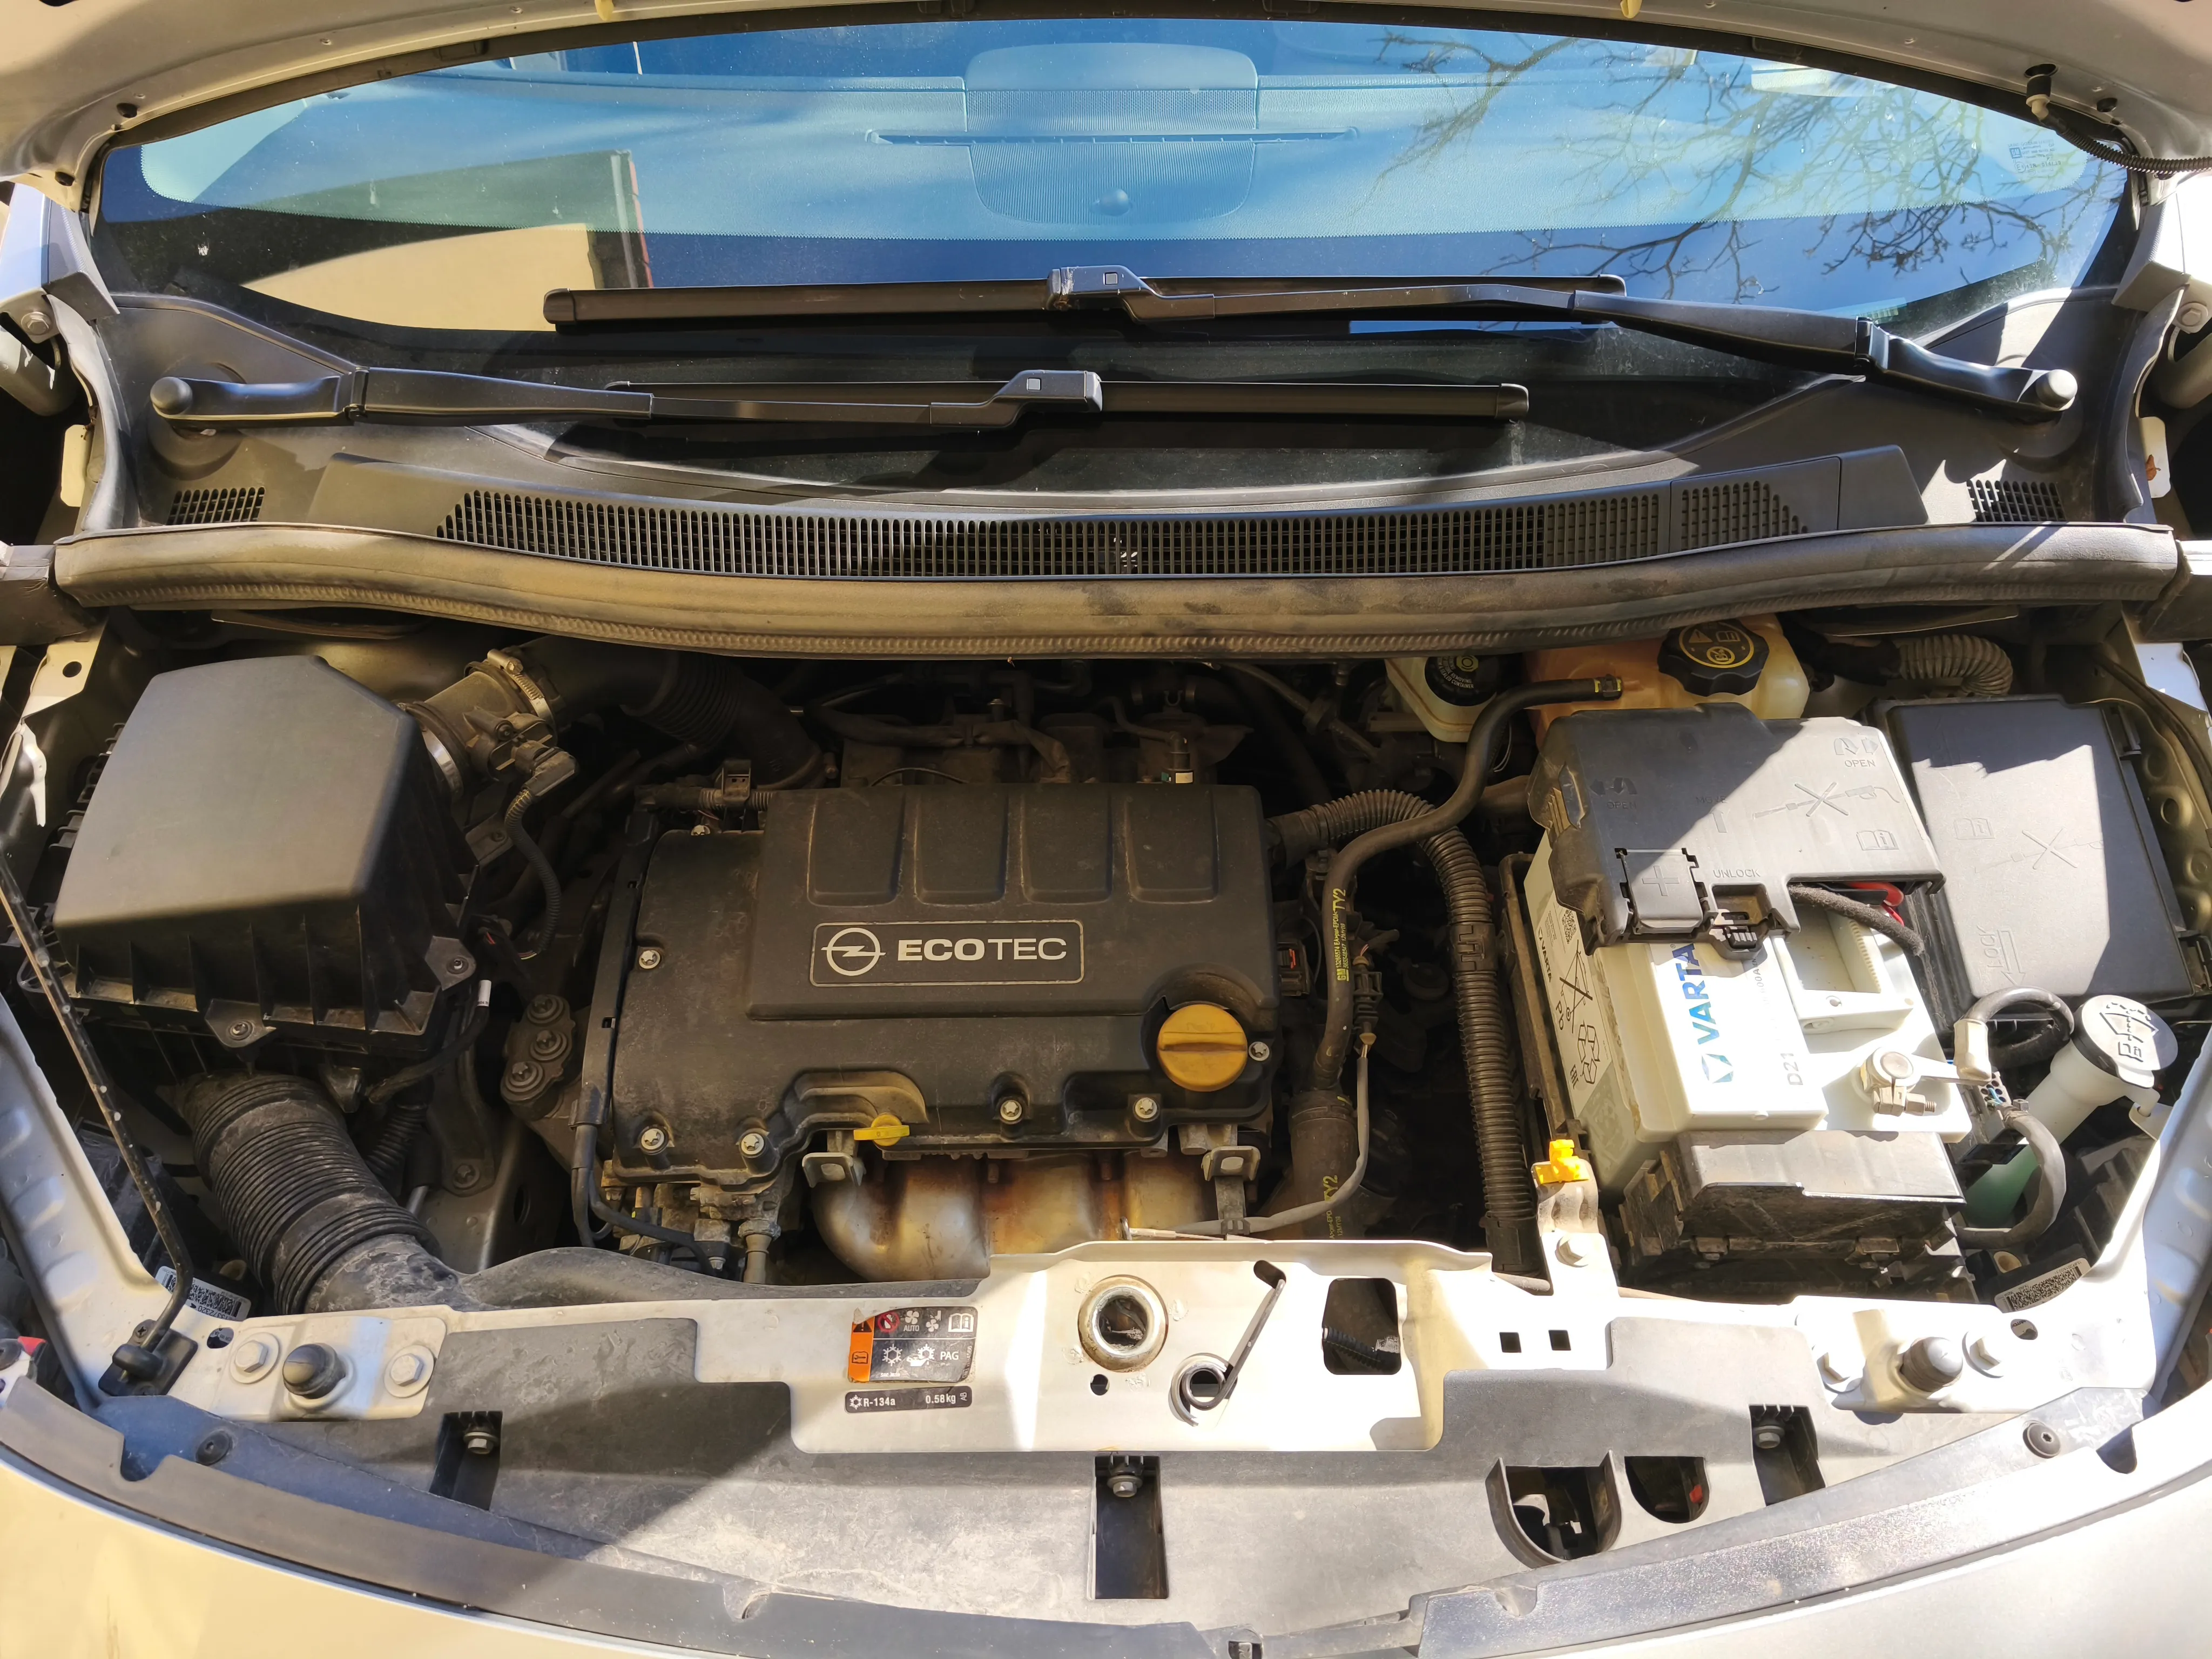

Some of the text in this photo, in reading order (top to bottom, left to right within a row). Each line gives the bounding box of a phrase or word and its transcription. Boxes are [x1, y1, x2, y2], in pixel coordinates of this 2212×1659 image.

[1844, 759, 1876, 767] OPEN
[1606, 801, 1637, 809] OPEN
[1712, 868, 1761, 878] UNLOCK
[1332, 888, 1346, 911] TY2
[898, 938, 1067, 961] ECOTEC
[1975, 925, 1996, 968] LOCK
[1541, 943, 1552, 982] VARTA
[1675, 943, 1719, 1044] VARTA
[1555, 1000, 1564, 1030] Pb
[1781, 1052, 1804, 1086] D21
[940, 1352, 959, 1360] PAG
[864, 1398, 896, 1407] R-134a
[960, 1392, 967, 1401] AB
